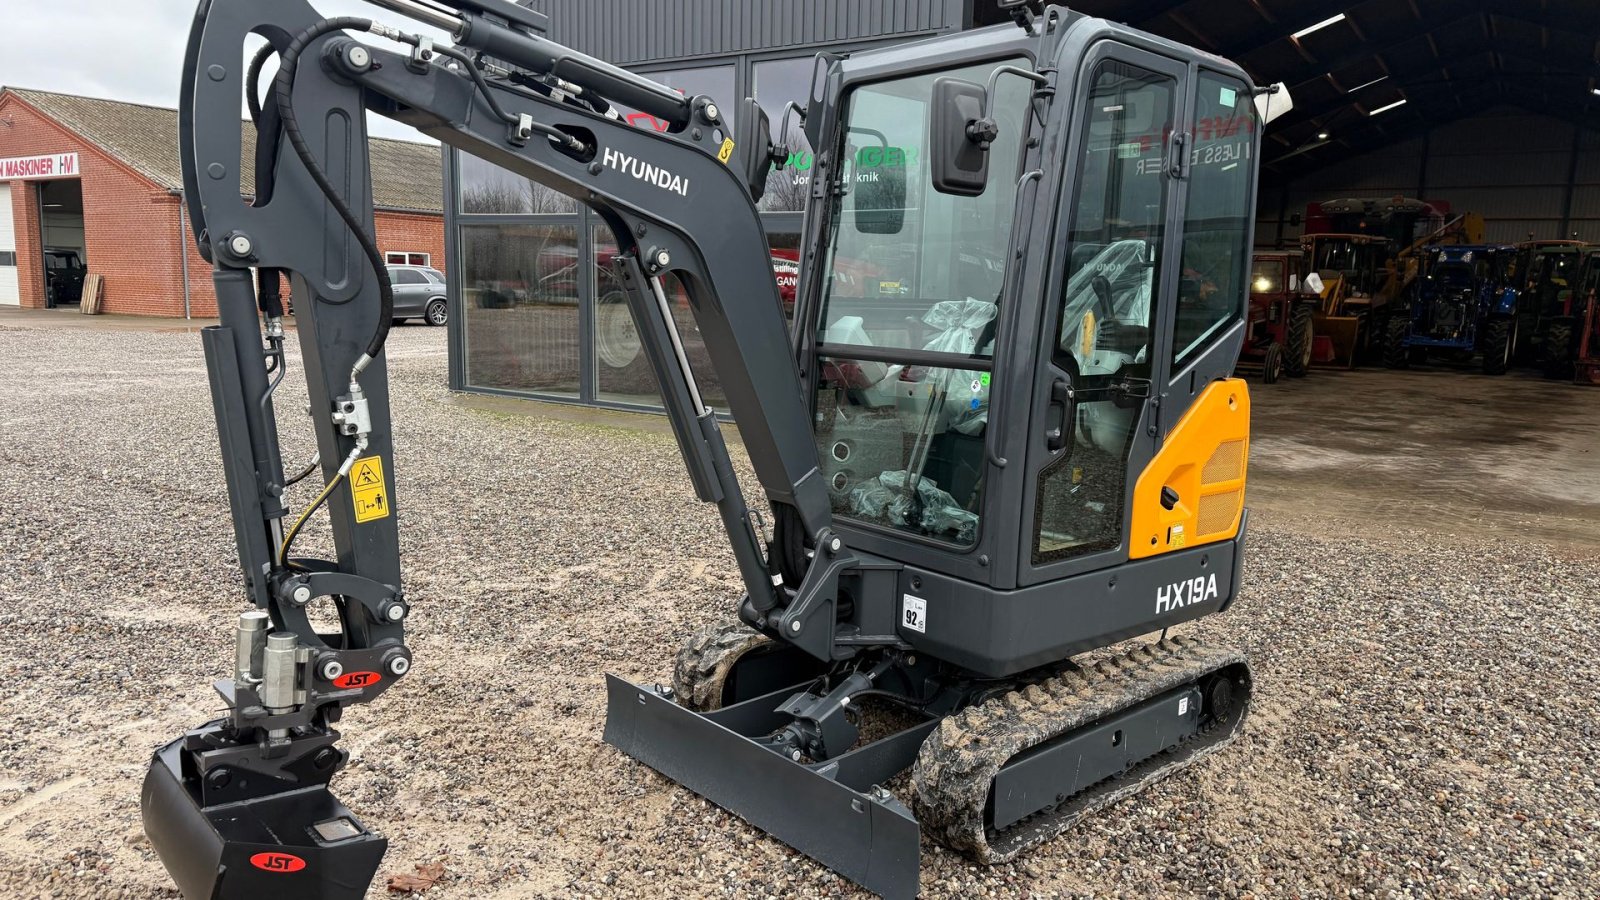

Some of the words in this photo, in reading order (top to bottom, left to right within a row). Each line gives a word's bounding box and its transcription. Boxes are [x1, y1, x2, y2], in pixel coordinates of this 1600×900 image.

[5, 157, 53, 177] MASKINER
[602, 147, 689, 197] HYUNDAI
[1155, 572, 1218, 615] HX19A
[905, 609, 917, 626] 92
[344, 673, 371, 687] JST
[263, 855, 295, 870] JST
